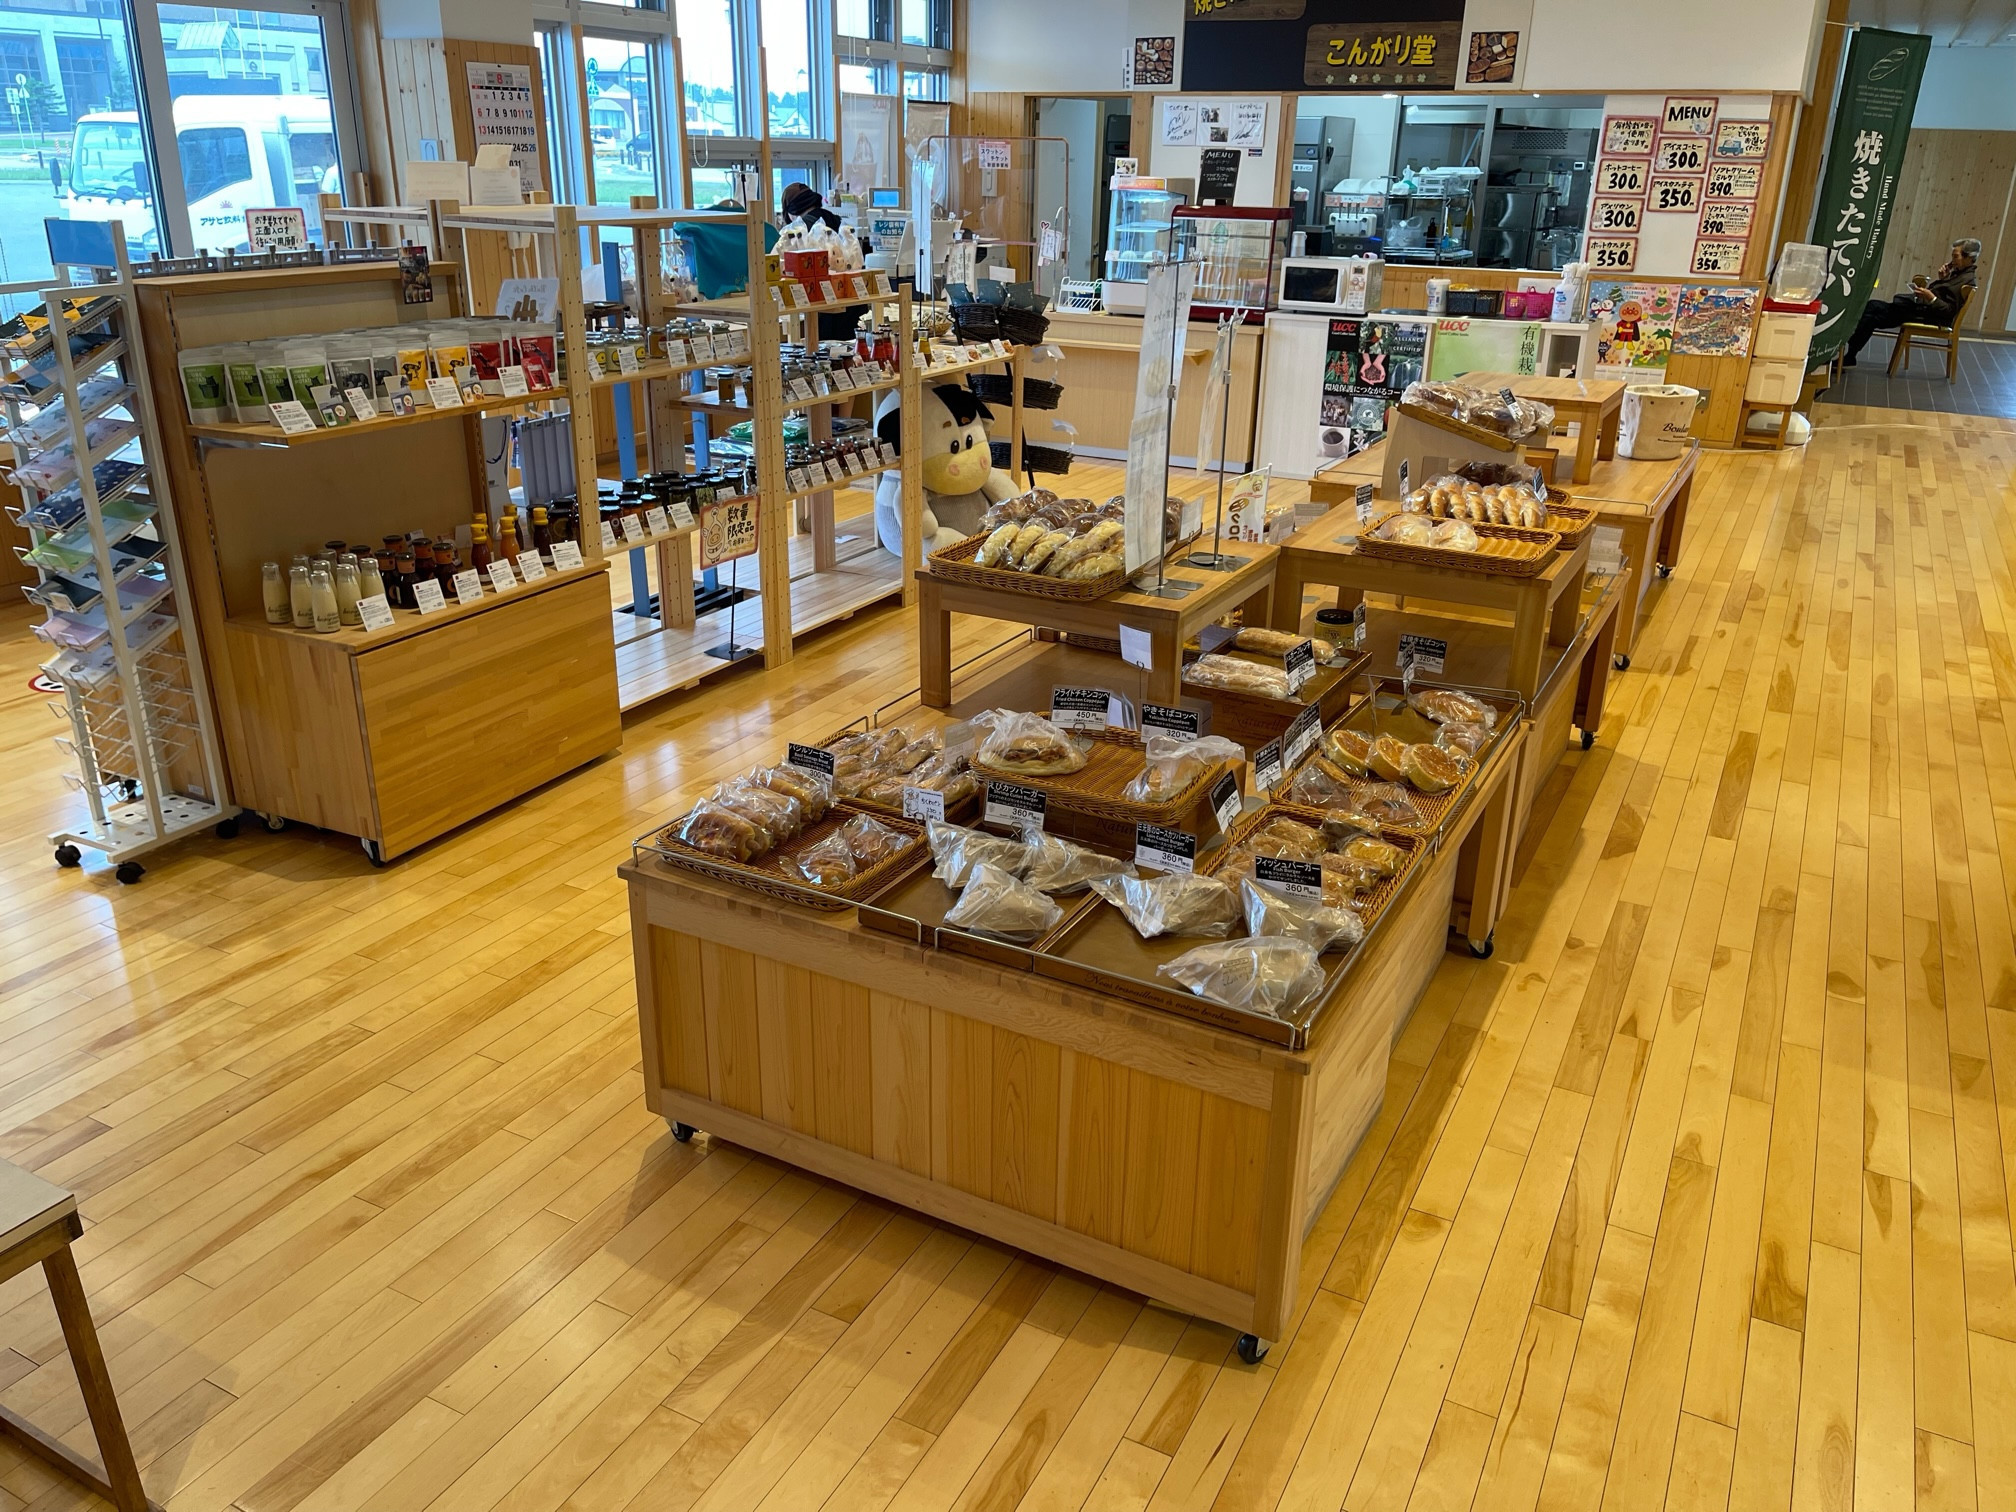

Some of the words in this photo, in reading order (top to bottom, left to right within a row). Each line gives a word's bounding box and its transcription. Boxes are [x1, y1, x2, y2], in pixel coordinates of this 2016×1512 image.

[1326, 34, 1437, 67] こんがり堂
[492, 91, 496, 100] 1
[500, 92, 505, 100] 2
[508, 92, 513, 100] 3
[516, 92, 521, 101] 4
[524, 92, 529, 101] 5
[478, 108, 482, 117] 6
[486, 108, 490, 117] 7
[494, 108, 499, 117] 8
[502, 109, 507, 117] 9
[510, 109, 517, 118] 10
[518, 109, 524, 118] 11
[525, 110, 533, 119] 12
[1668, 106, 1712, 121] MENU
[478, 126, 486, 135] 13
[487, 126, 495, 135] 14
[495, 126, 503, 135] 15
[503, 126, 511, 135] 16
[512, 126, 519, 135] 17
[519, 126, 527, 135] 18
[527, 127, 535, 136] 19
[513, 143, 521, 152] 24
[521, 143, 529, 152] 25
[529, 144, 536, 152] 26
[1663, 143, 1703, 151] アイスコーヒー
[1205, 151, 1234, 159] MENU
[1604, 163, 1642, 172] ホットコーヒー
[1713, 167, 1755, 175] ソフトクリーム
[1882, 174, 1894, 200] Hand
[1707, 205, 1749, 213] ソフトクリーム
[1875, 201, 1888, 226] Made
[254, 215, 297, 227] お手数ですが
[254, 226, 289, 236] 正面入口を
[1701, 243, 1740, 251] ソフトクリーム
[1866, 228, 1882, 260] Bakery
[1439, 319, 1470, 332] UCC
[1518, 326, 1538, 376] 有機栽
[1324, 383, 1404, 396] 環境保護につながるコー
[727, 502, 749, 524] 数量
[727, 521, 755, 540] 限定品
[1142, 704, 1197, 720] やきそばコッペ
[988, 782, 1046, 798] えびカツバーガー
[1023, 795, 1039, 803] Burger
[1256, 856, 1321, 872] フィッシュバーガー
[1083, 972, 1113, 991] Nous
[1114, 984, 1165, 1004] travaillons
[1175, 1000, 1200, 1013] votre
[1201, 1007, 1241, 1025] bonheur
